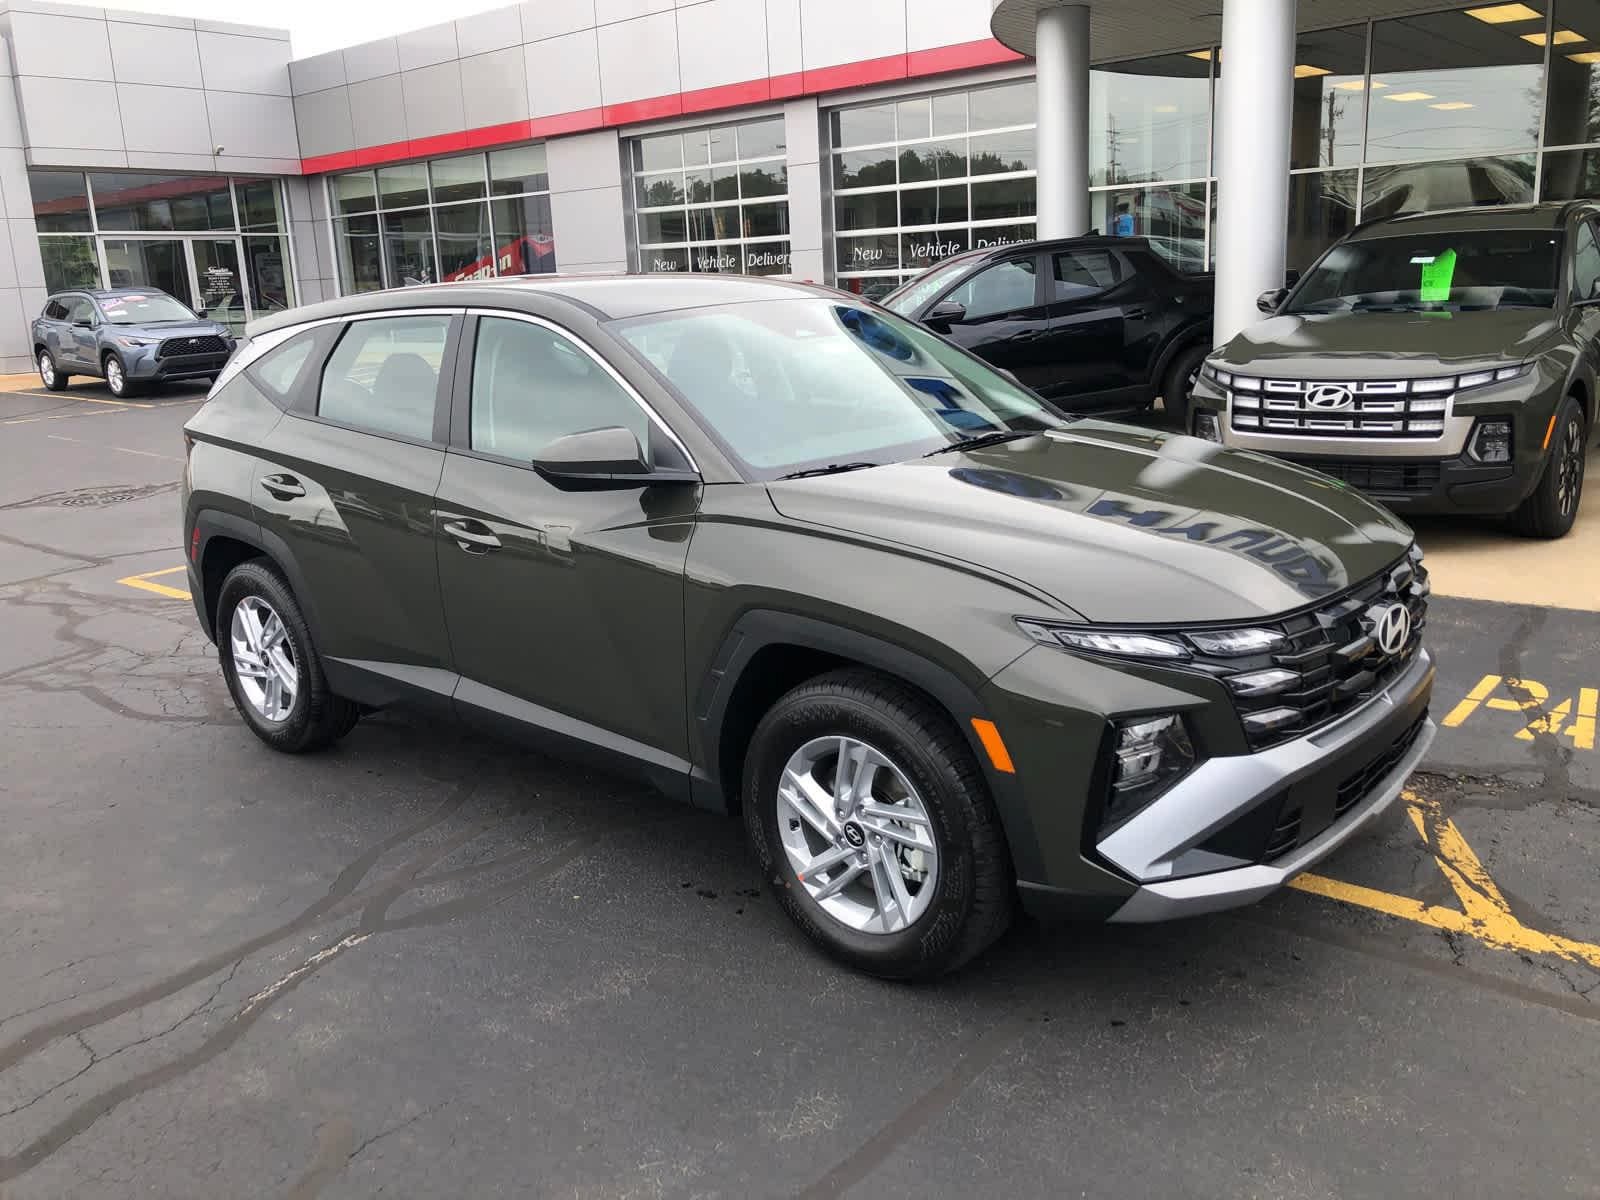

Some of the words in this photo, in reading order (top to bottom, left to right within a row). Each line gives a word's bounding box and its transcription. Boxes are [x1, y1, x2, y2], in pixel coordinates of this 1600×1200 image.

[853, 247, 882, 261] New
[910, 241, 960, 258] Vehicle
[977, 236, 1034, 249] Deli
[653, 258, 677, 271] New
[697, 254, 736, 269] Vehicle
